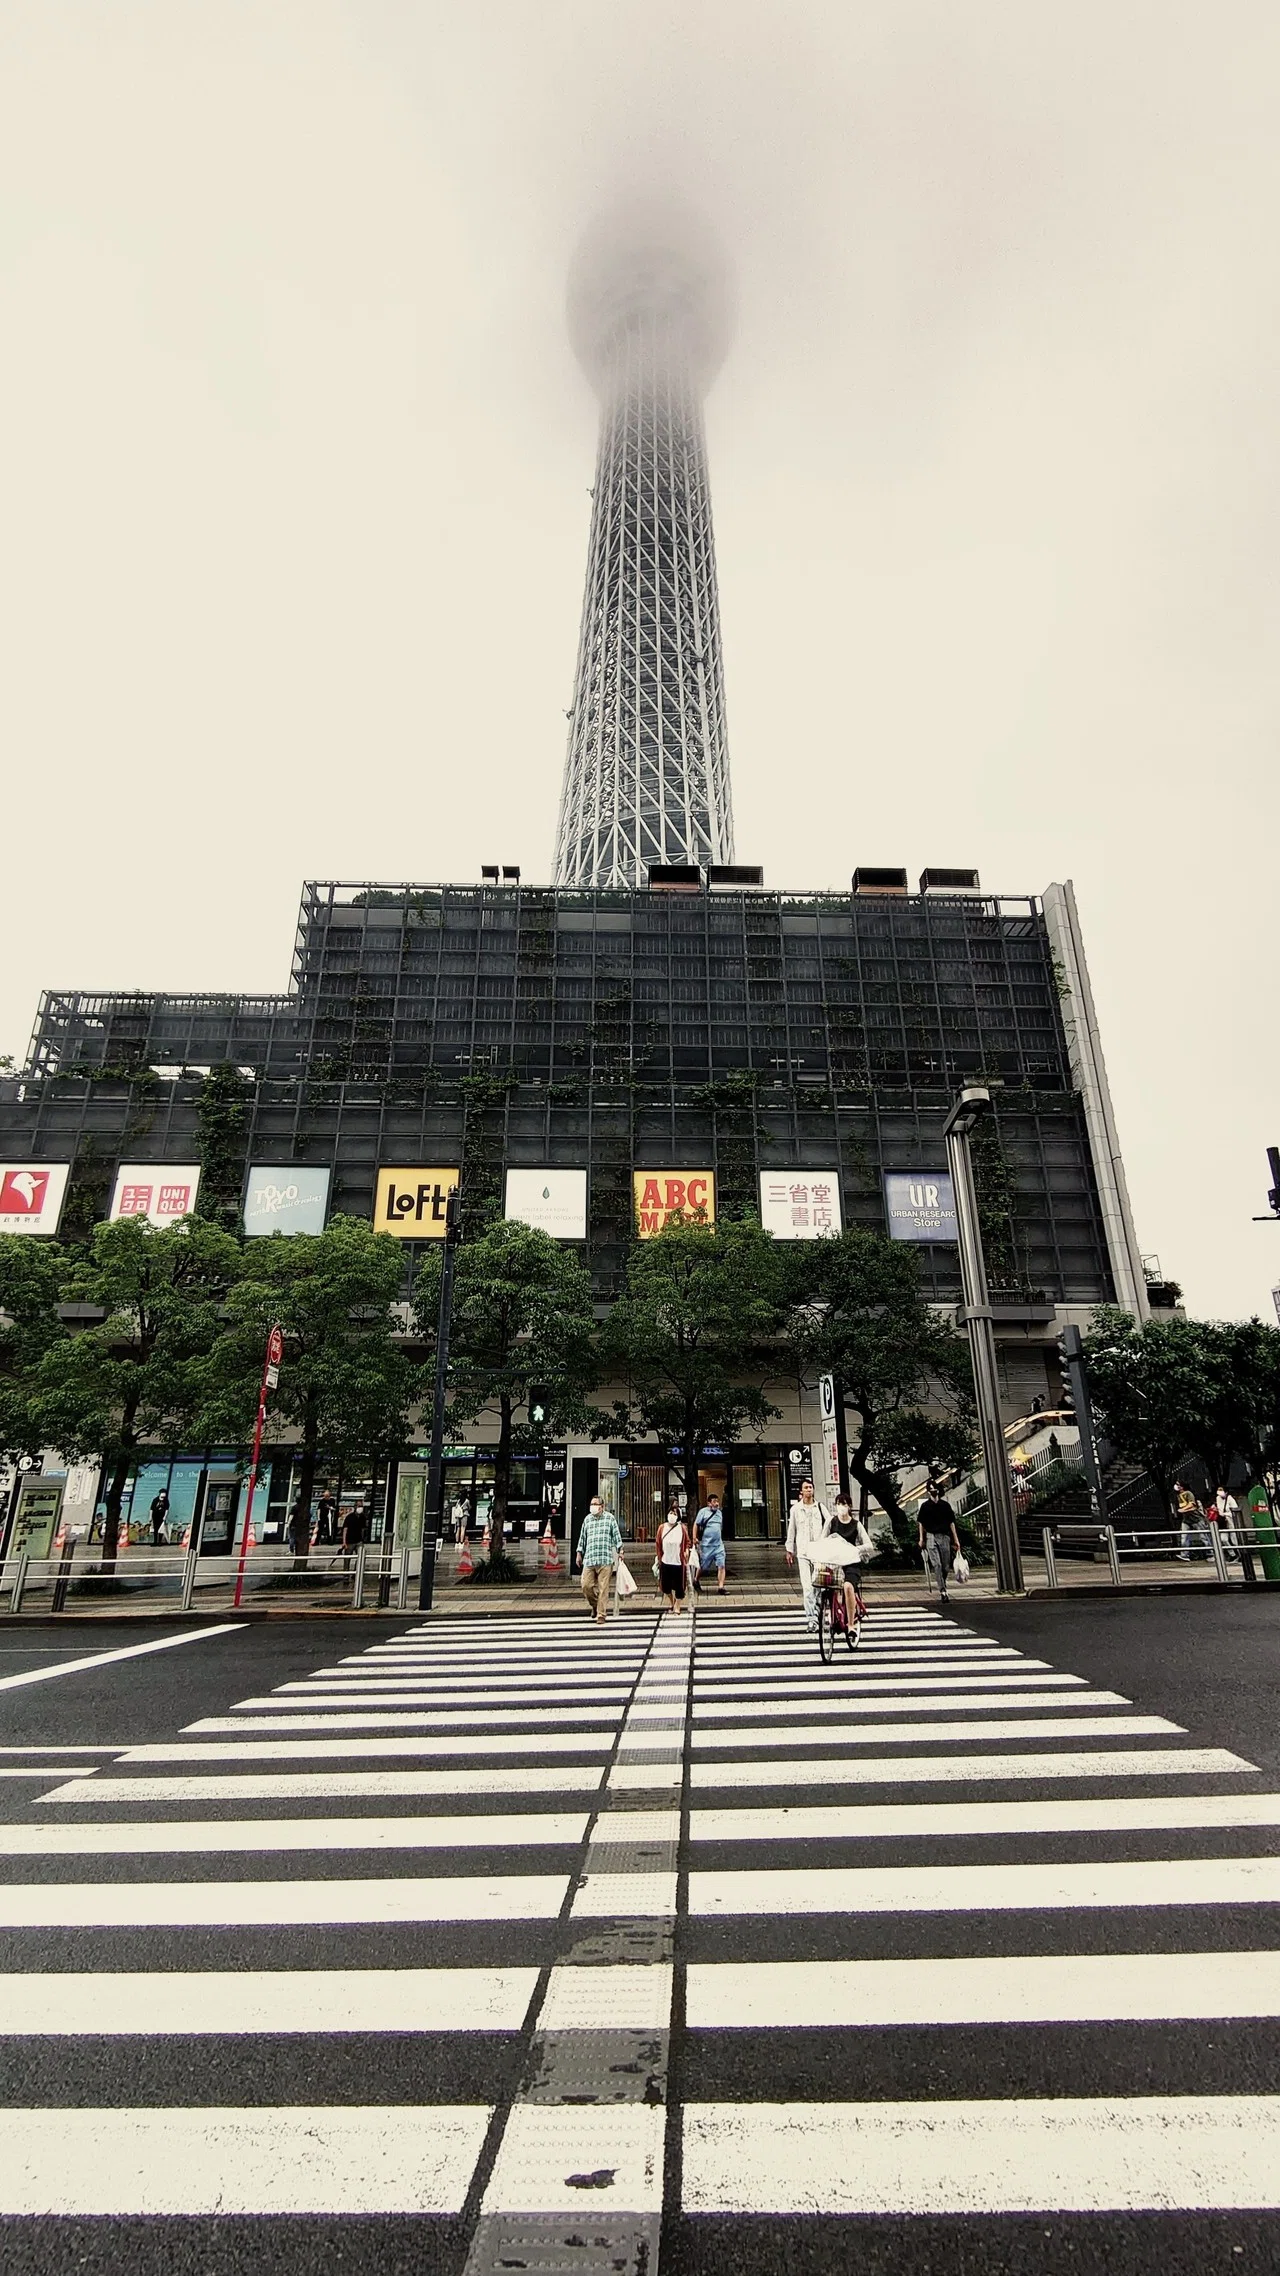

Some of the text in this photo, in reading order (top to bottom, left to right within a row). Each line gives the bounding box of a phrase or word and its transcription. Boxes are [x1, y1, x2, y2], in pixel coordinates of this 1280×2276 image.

[125, 1188, 149, 1199] ユニ
[163, 1188, 185, 1199] UNI
[640, 1179, 708, 1209] ABC
[769, 1184, 831, 1203] 三省堂
[909, 1184, 939, 1208] UR
[122, 1200, 148, 1211] クロ
[161, 1200, 184, 1212] QLO
[791, 1207, 832, 1226] 書店
[891, 1210, 918, 1218] URBAN
[914, 1218, 941, 1227] Store
